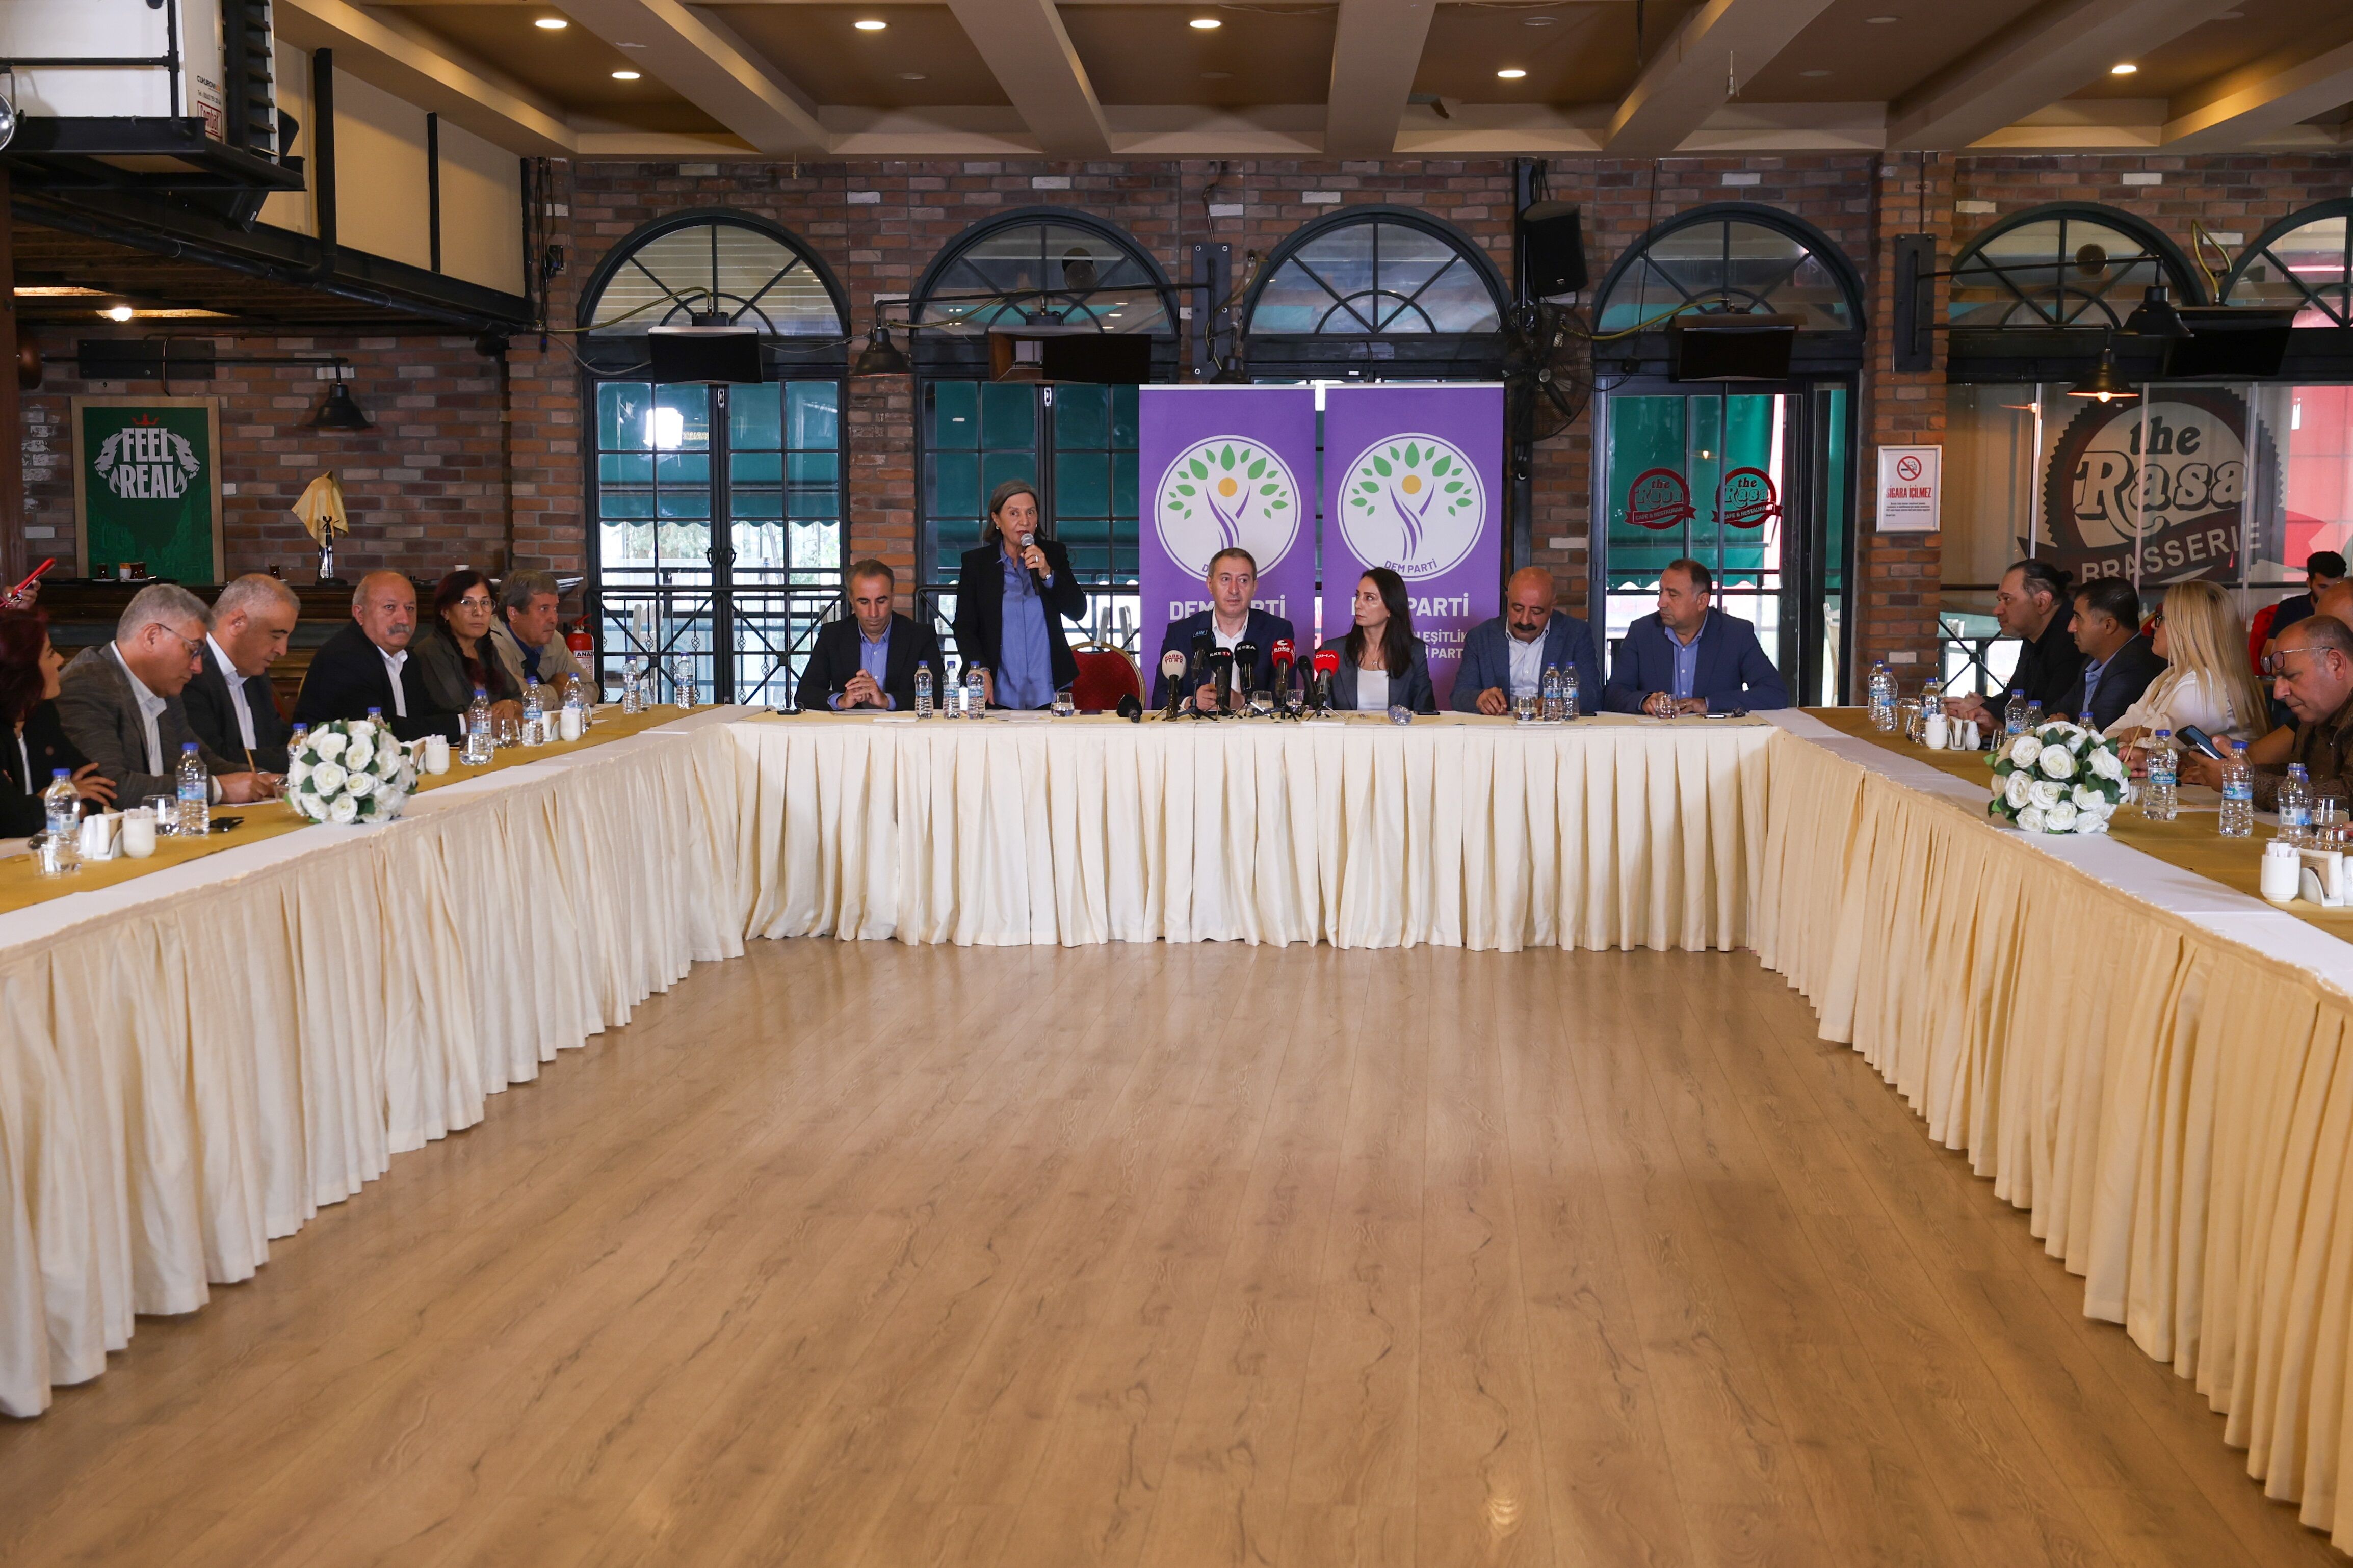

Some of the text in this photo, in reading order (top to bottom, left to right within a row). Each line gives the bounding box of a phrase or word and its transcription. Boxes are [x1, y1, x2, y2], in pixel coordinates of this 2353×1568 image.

[2130, 416, 2201, 455] the
[121, 428, 173, 462] FEEL
[119, 464, 180, 498] REAL
[1652, 479, 1670, 489] the
[1738, 477, 1757, 487] the
[1886, 485, 1931, 499] SİGARA İÇİLMEZ
[2071, 450, 2247, 537] Rasa
[1741, 504, 1773, 516] RESTAURANT
[2082, 522, 2262, 583] BRASSERIE
[1384, 559, 1437, 573] DEM PARTİ
[1407, 593, 1469, 616] PARTİ
[1431, 648, 1463, 658] PART
